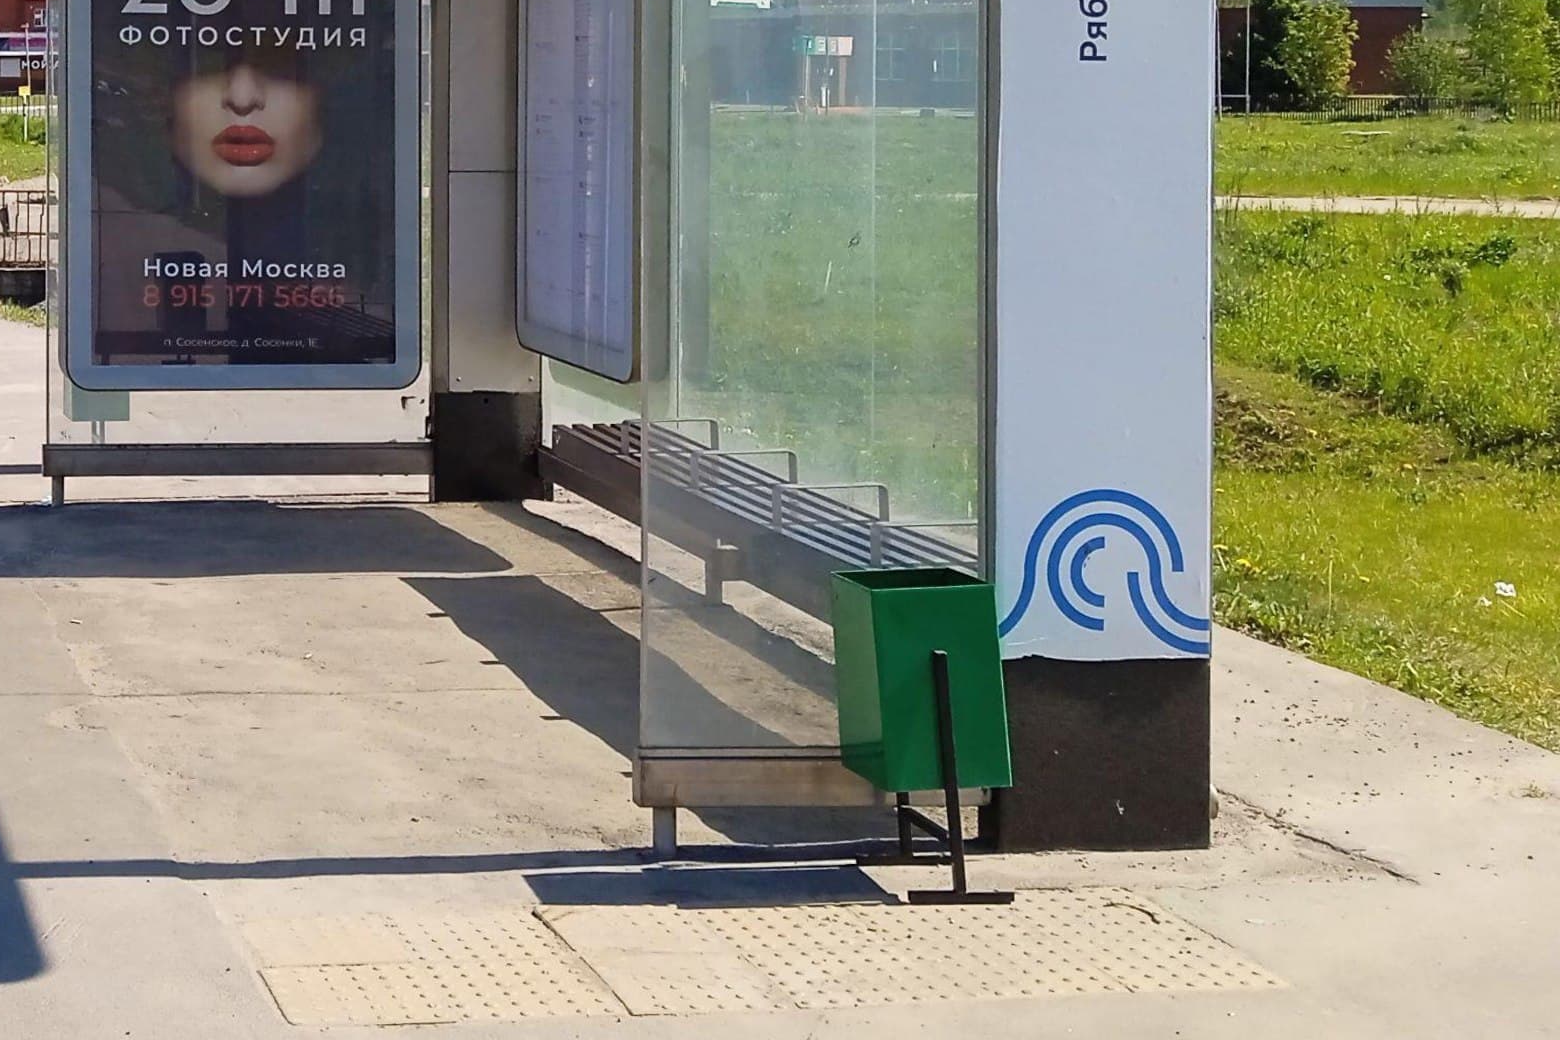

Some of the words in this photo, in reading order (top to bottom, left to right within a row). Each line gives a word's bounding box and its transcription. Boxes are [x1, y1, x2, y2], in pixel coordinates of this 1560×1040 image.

[119, 25, 366, 50] ФОТОСТУДИЯ
[143, 258, 228, 278] Новая
[242, 259, 346, 278] Москва
[143, 284, 160, 307] 8
[170, 284, 215, 307] 915
[226, 284, 264, 307] 171
[274, 285, 345, 308] 5666
